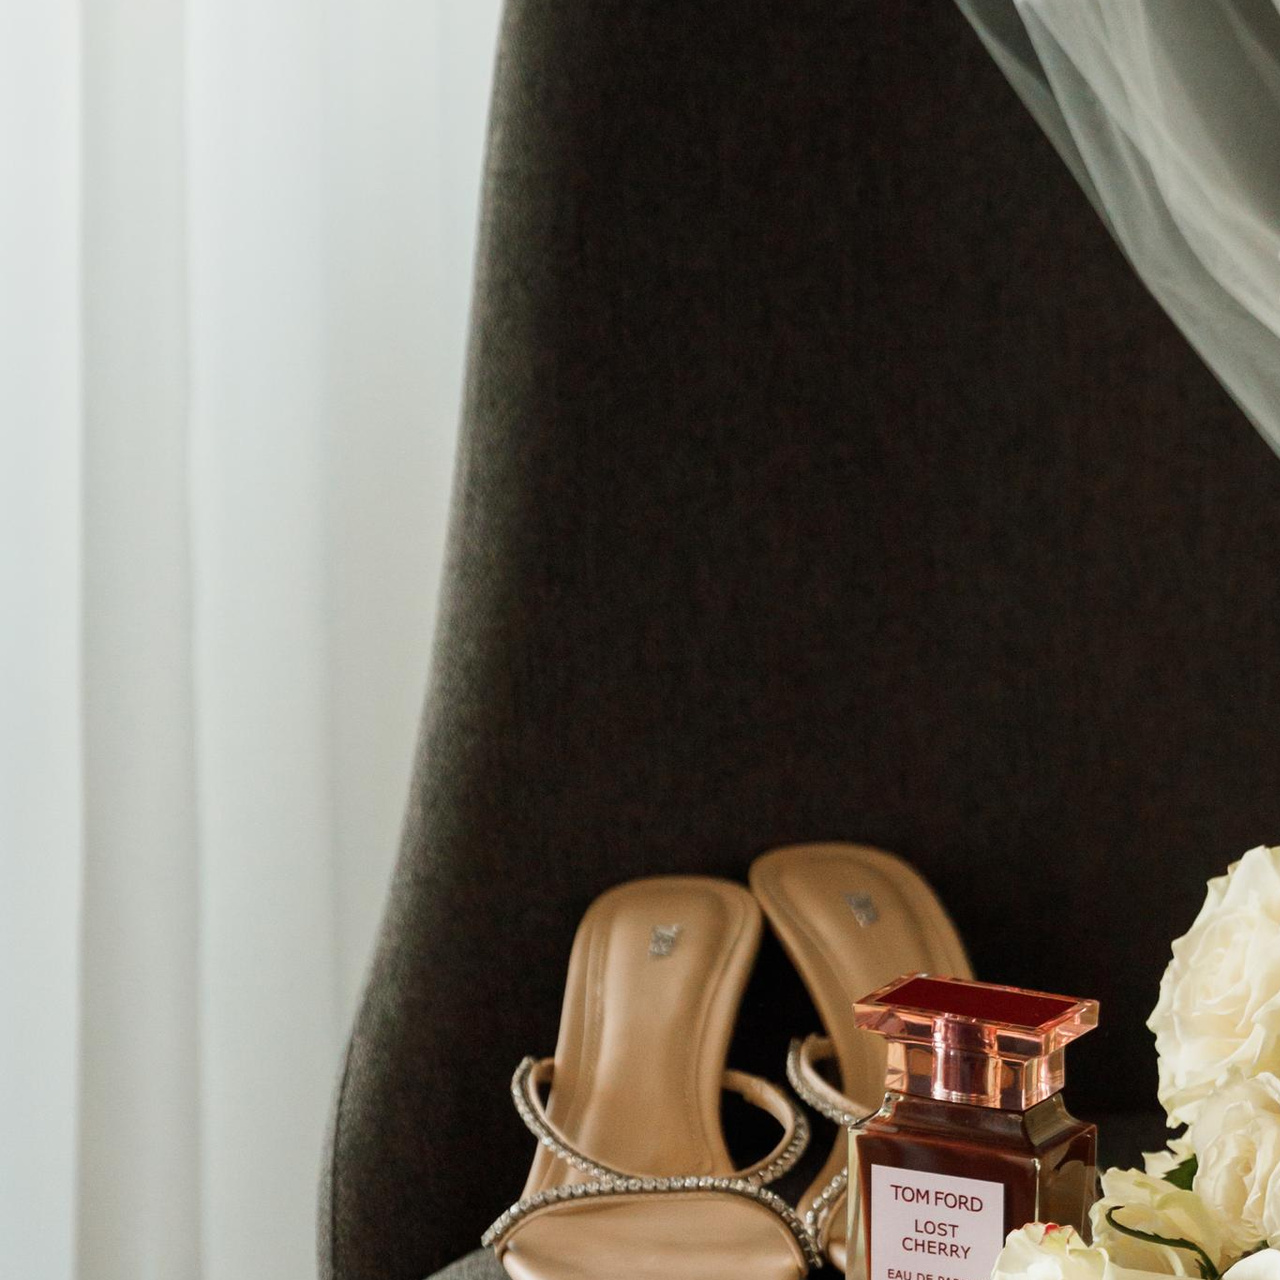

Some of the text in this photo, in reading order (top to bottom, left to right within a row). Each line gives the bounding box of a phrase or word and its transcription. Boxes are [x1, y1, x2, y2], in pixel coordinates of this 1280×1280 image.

[890, 1184, 983, 1212] TOM FORD
[914, 1219, 959, 1238] LOST
[902, 1237, 971, 1259] CHERRY
[887, 1268, 912, 1280] EAU
